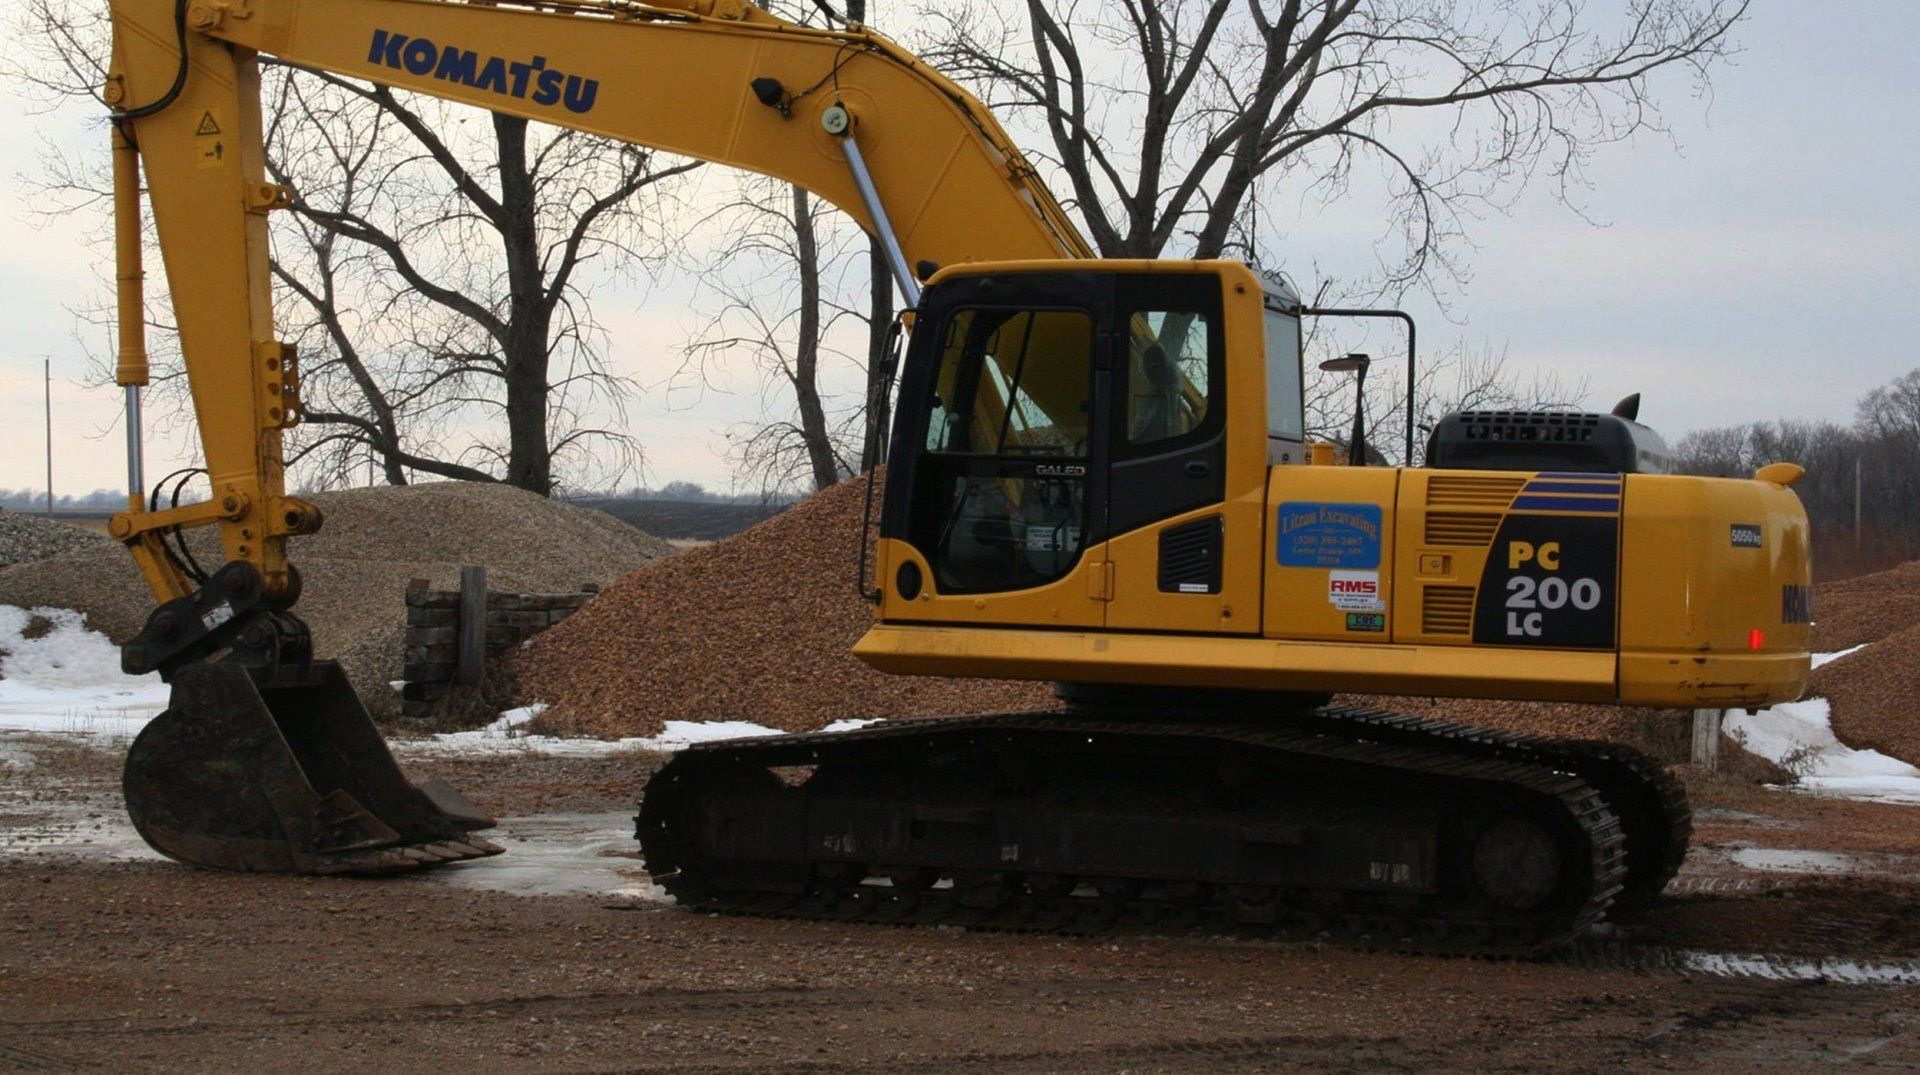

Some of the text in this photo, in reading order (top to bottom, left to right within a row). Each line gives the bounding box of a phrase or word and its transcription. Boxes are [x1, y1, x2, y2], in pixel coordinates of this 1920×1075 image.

[367, 28, 600, 113] KOMATSU
[1731, 529, 1753, 542] 5050
[1508, 541, 1560, 571] PC
[1331, 580, 1377, 593] RMS
[1505, 575, 1601, 611] 200
[1507, 611, 1542, 637] LC
